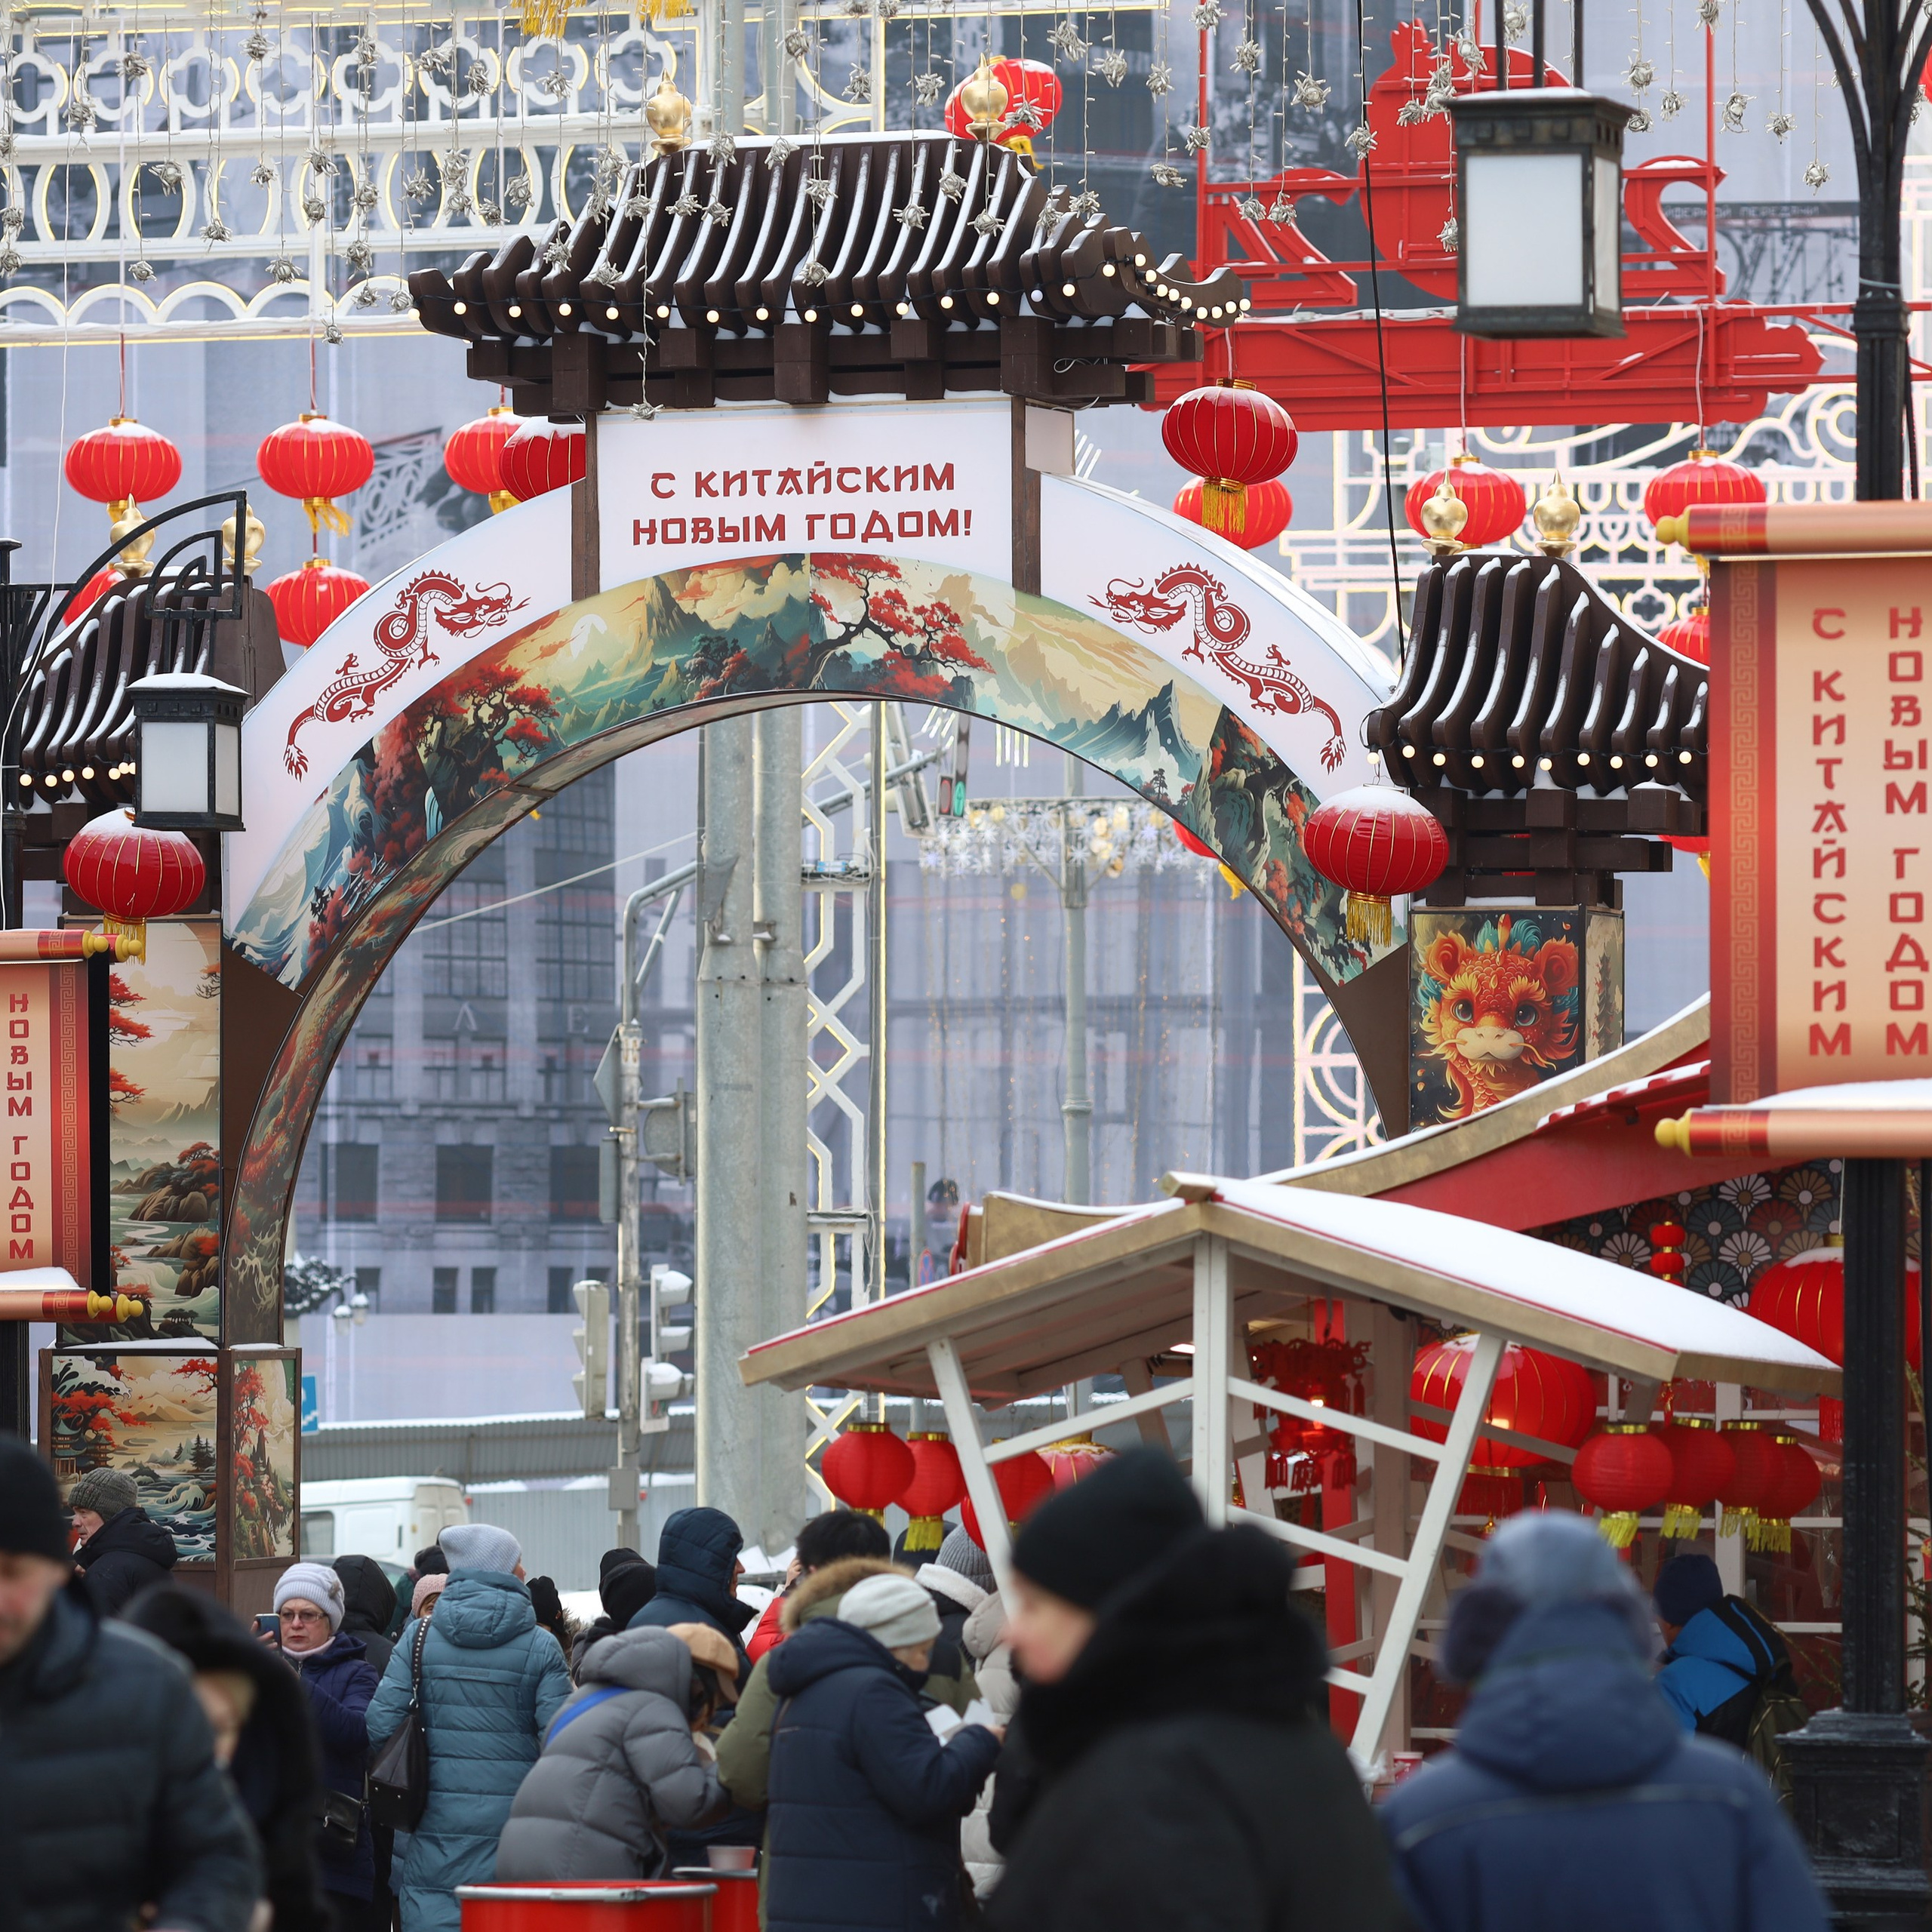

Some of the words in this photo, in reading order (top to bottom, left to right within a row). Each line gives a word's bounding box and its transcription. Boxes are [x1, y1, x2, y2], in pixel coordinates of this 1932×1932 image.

[632, 512, 786, 546] НОВЫМ
[804, 508, 973, 544] ГОДОМ!
[651, 472, 676, 500] С
[694, 460, 955, 498] КИТАЙСКИМ
[1811, 607, 1847, 641] С
[1883, 606, 1928, 814] НОВЫМ
[1808, 669, 1852, 1057] КИТАЙСКИМ
[1884, 848, 1930, 1057] ГОДОМ
[7, 992, 33, 1117] НОВЫМ
[8, 1135, 35, 1260] ГОДОМ
